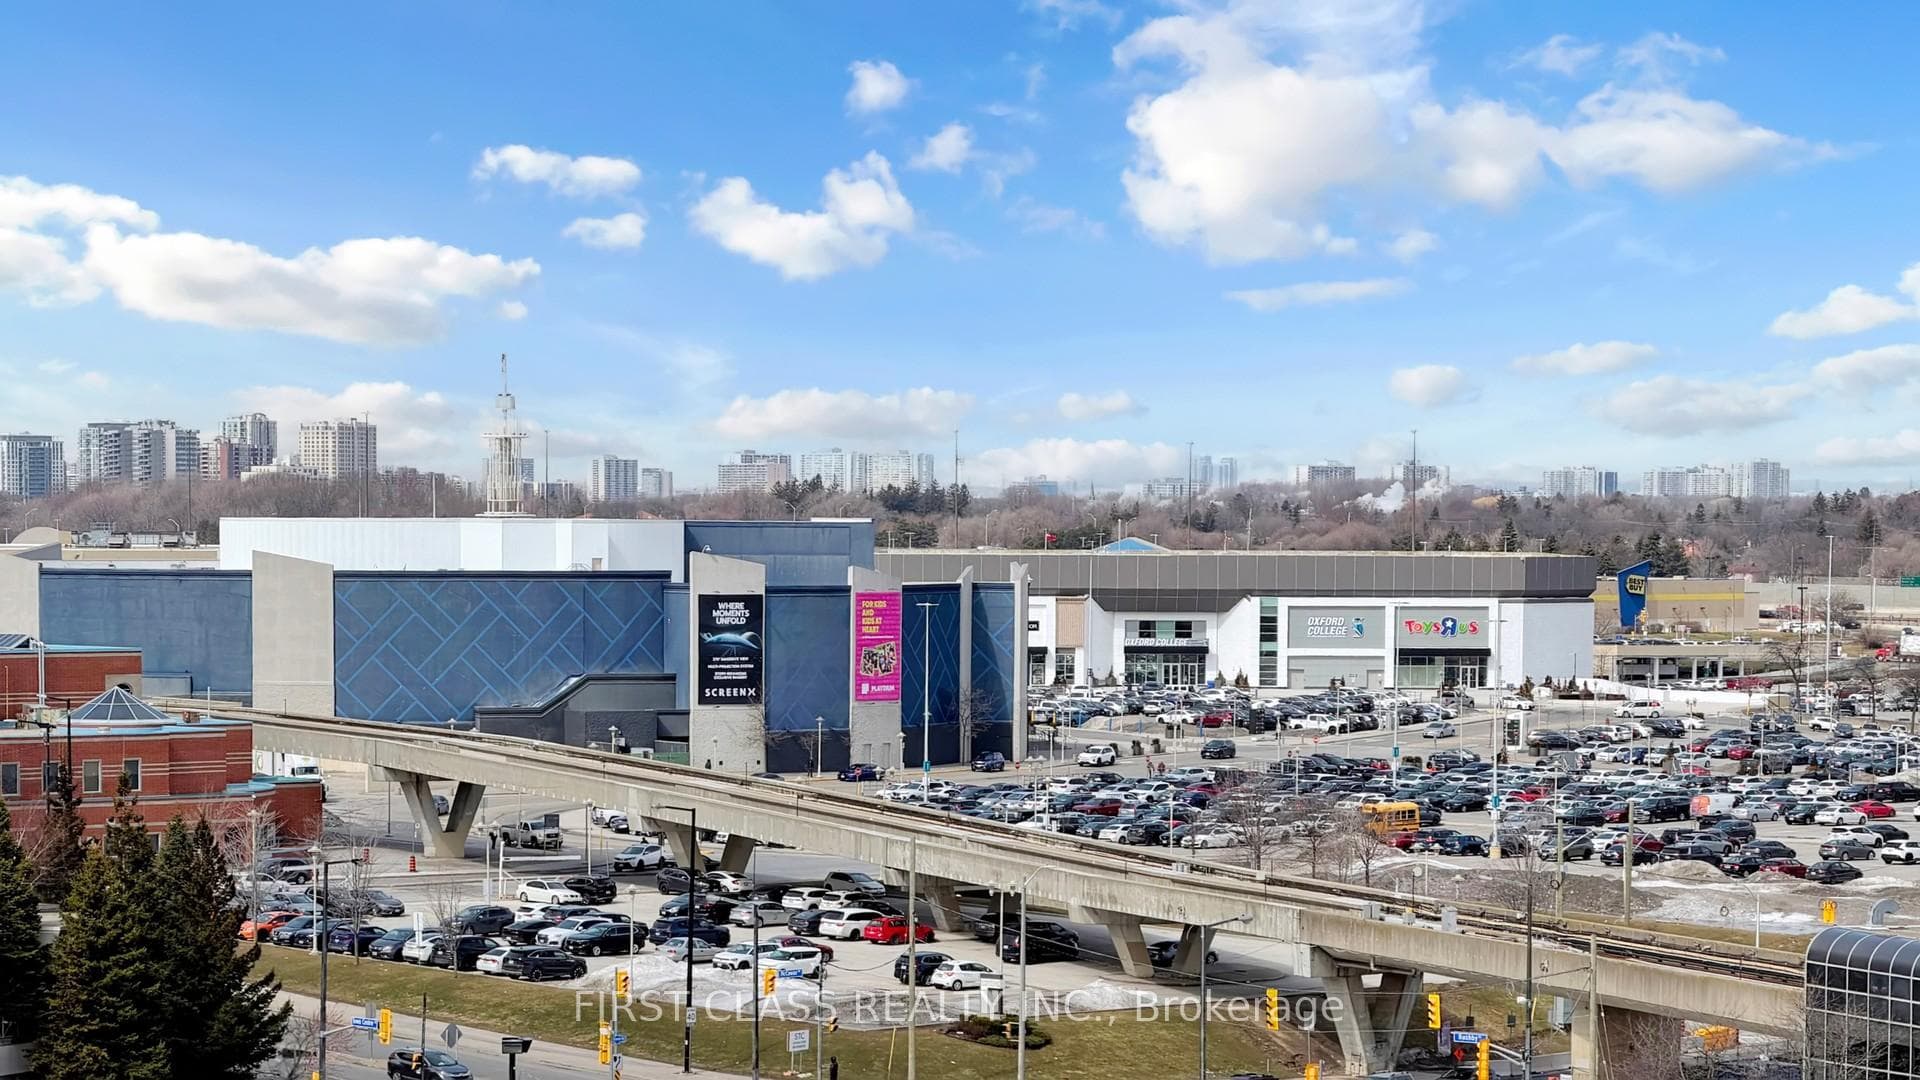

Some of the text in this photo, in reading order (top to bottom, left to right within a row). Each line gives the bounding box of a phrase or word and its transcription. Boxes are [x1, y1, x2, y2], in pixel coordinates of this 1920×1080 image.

[1628, 577, 1645, 585] BEST
[1628, 584, 1643, 592] BUY
[718, 602, 745, 610] WHERE
[862, 600, 887, 608] FOR KIDS
[712, 609, 750, 617] MOMENTS
[862, 609, 875, 617] AND
[716, 617, 747, 625] UNFOLD
[1307, 616, 1345, 626] OXFORD
[862, 625, 879, 633] HEART
[1307, 626, 1349, 635] COLLEGE
[1125, 638, 1154, 646] OXFORD
[1155, 638, 1187, 646] COLLEGE
[705, 687, 757, 697] SCREENX
[688, 1013, 696, 1021] 40
[794, 1031, 805, 1040] STC
